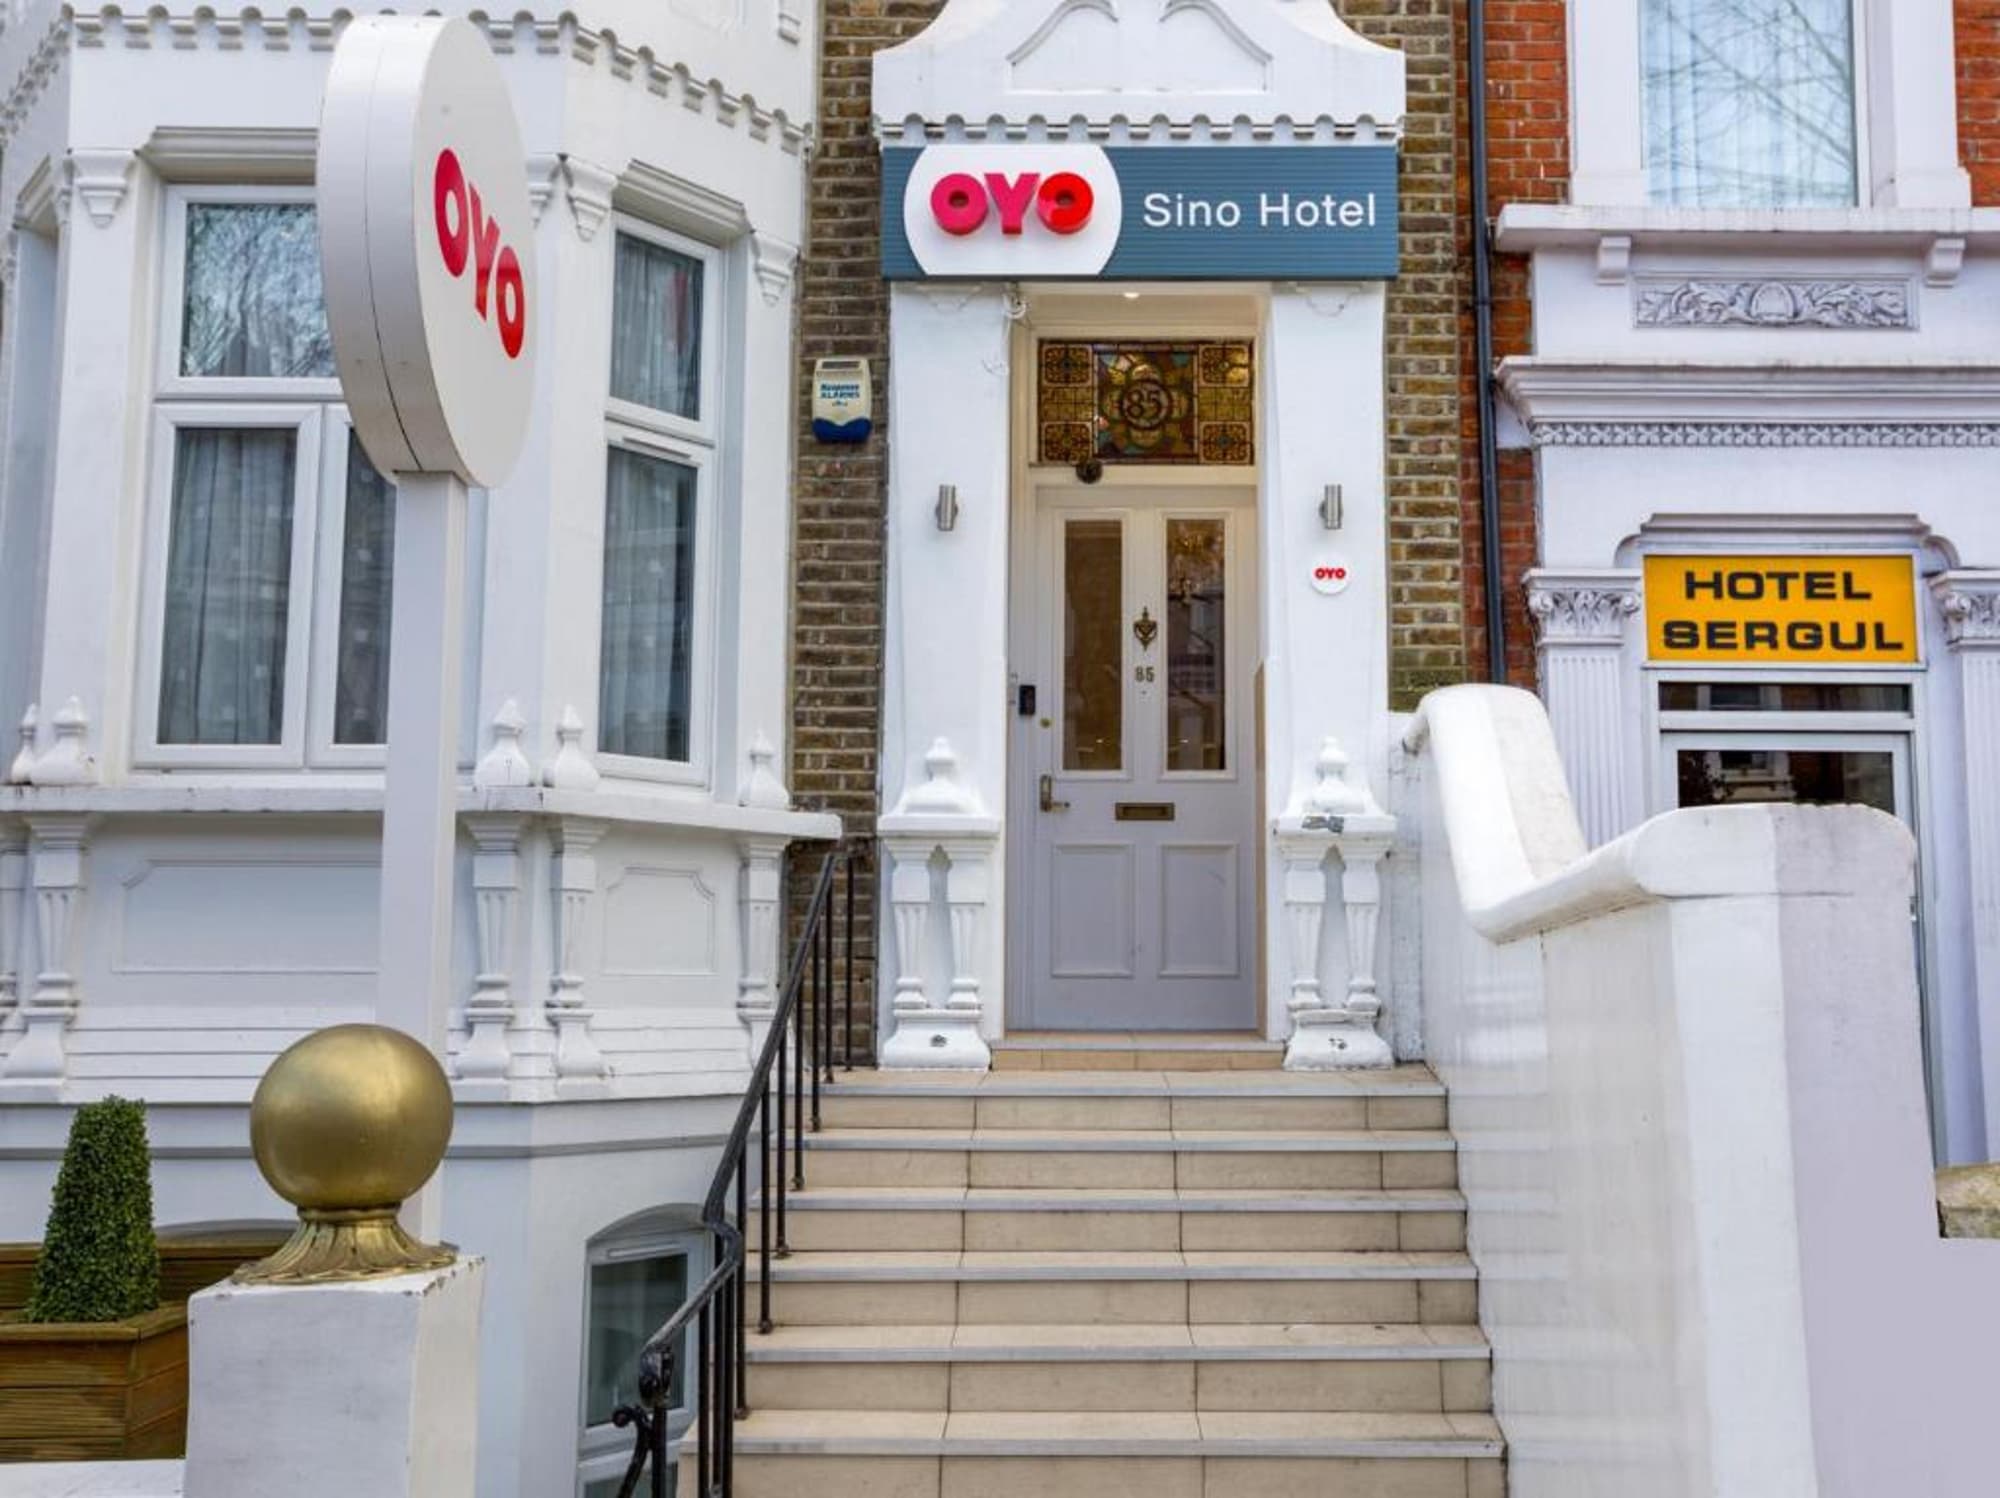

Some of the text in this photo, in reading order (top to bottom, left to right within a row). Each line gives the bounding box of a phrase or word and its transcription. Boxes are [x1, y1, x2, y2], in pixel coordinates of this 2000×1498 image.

[930, 171, 1375, 235] OYO Sino Hotel
[434, 148, 525, 358] OYO
[1127, 389, 1163, 418] 85
[1314, 567, 1346, 580] OYO
[1685, 571, 1871, 600] HOTEL
[1663, 621, 1903, 650] SERGUL
[1135, 666, 1155, 682] 85
